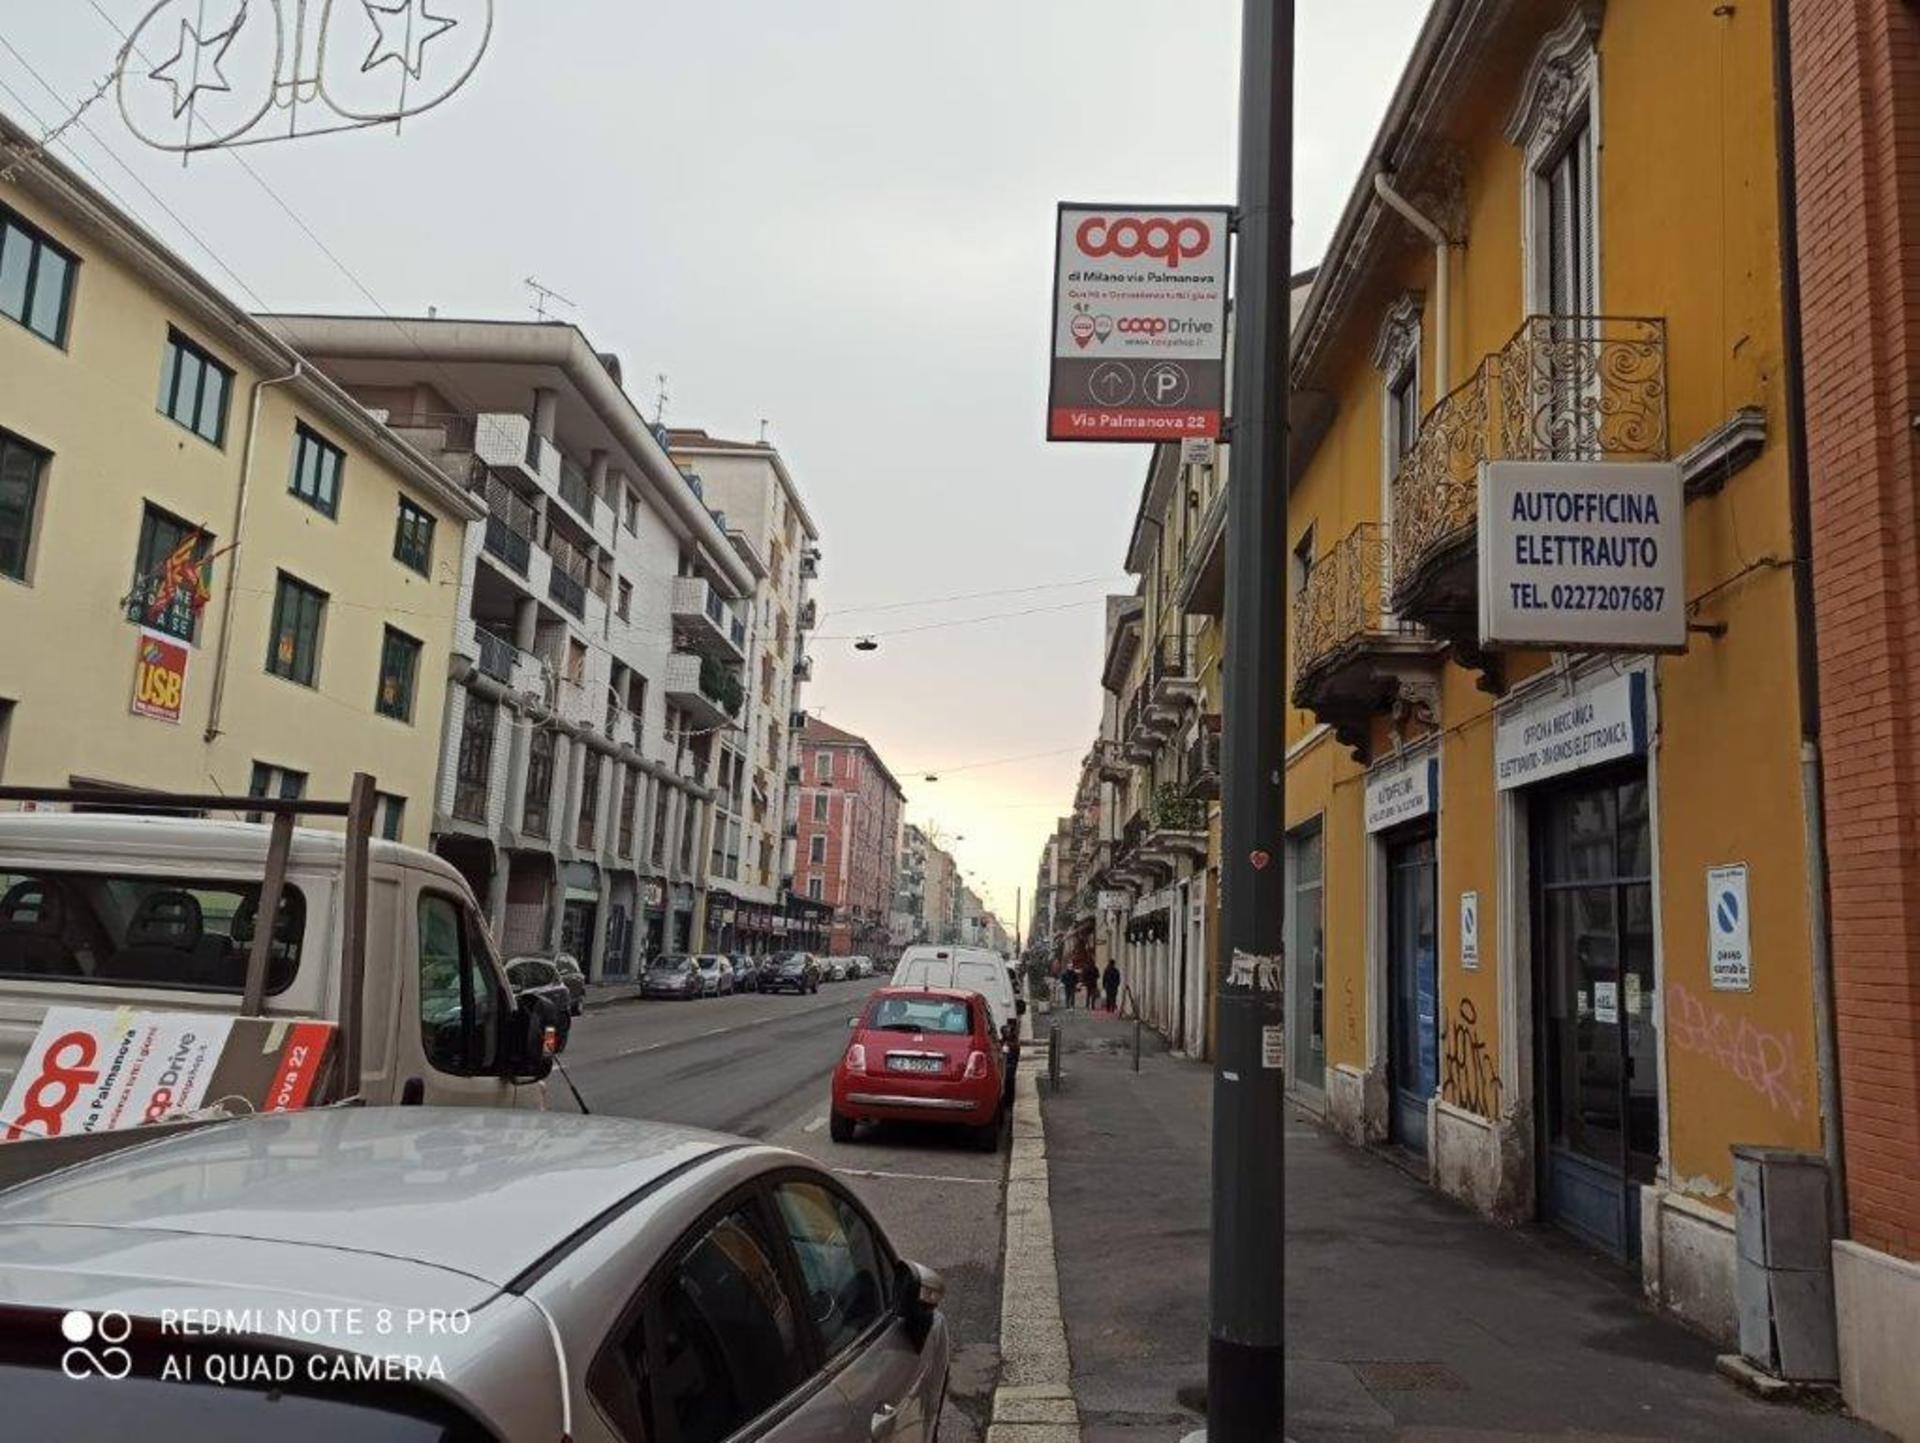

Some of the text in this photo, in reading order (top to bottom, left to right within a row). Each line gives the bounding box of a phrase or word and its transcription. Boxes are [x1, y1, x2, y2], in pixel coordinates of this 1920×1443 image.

[1076, 217, 1211, 268] coop
[1068, 271, 1215, 283] di Milano via Palmanova
[1157, 373, 1178, 401] P
[1071, 415, 1206, 429] Via Palmanova 22
[1512, 491, 1660, 525] AUTOFFICINA
[1516, 535, 1658, 568] ELETTRAUTO
[1510, 583, 1665, 612] TEL. 0227207687
[137, 660, 182, 708] USB
[92, 1029, 136, 1109] Palmanova
[289, 1045, 309, 1068] 22
